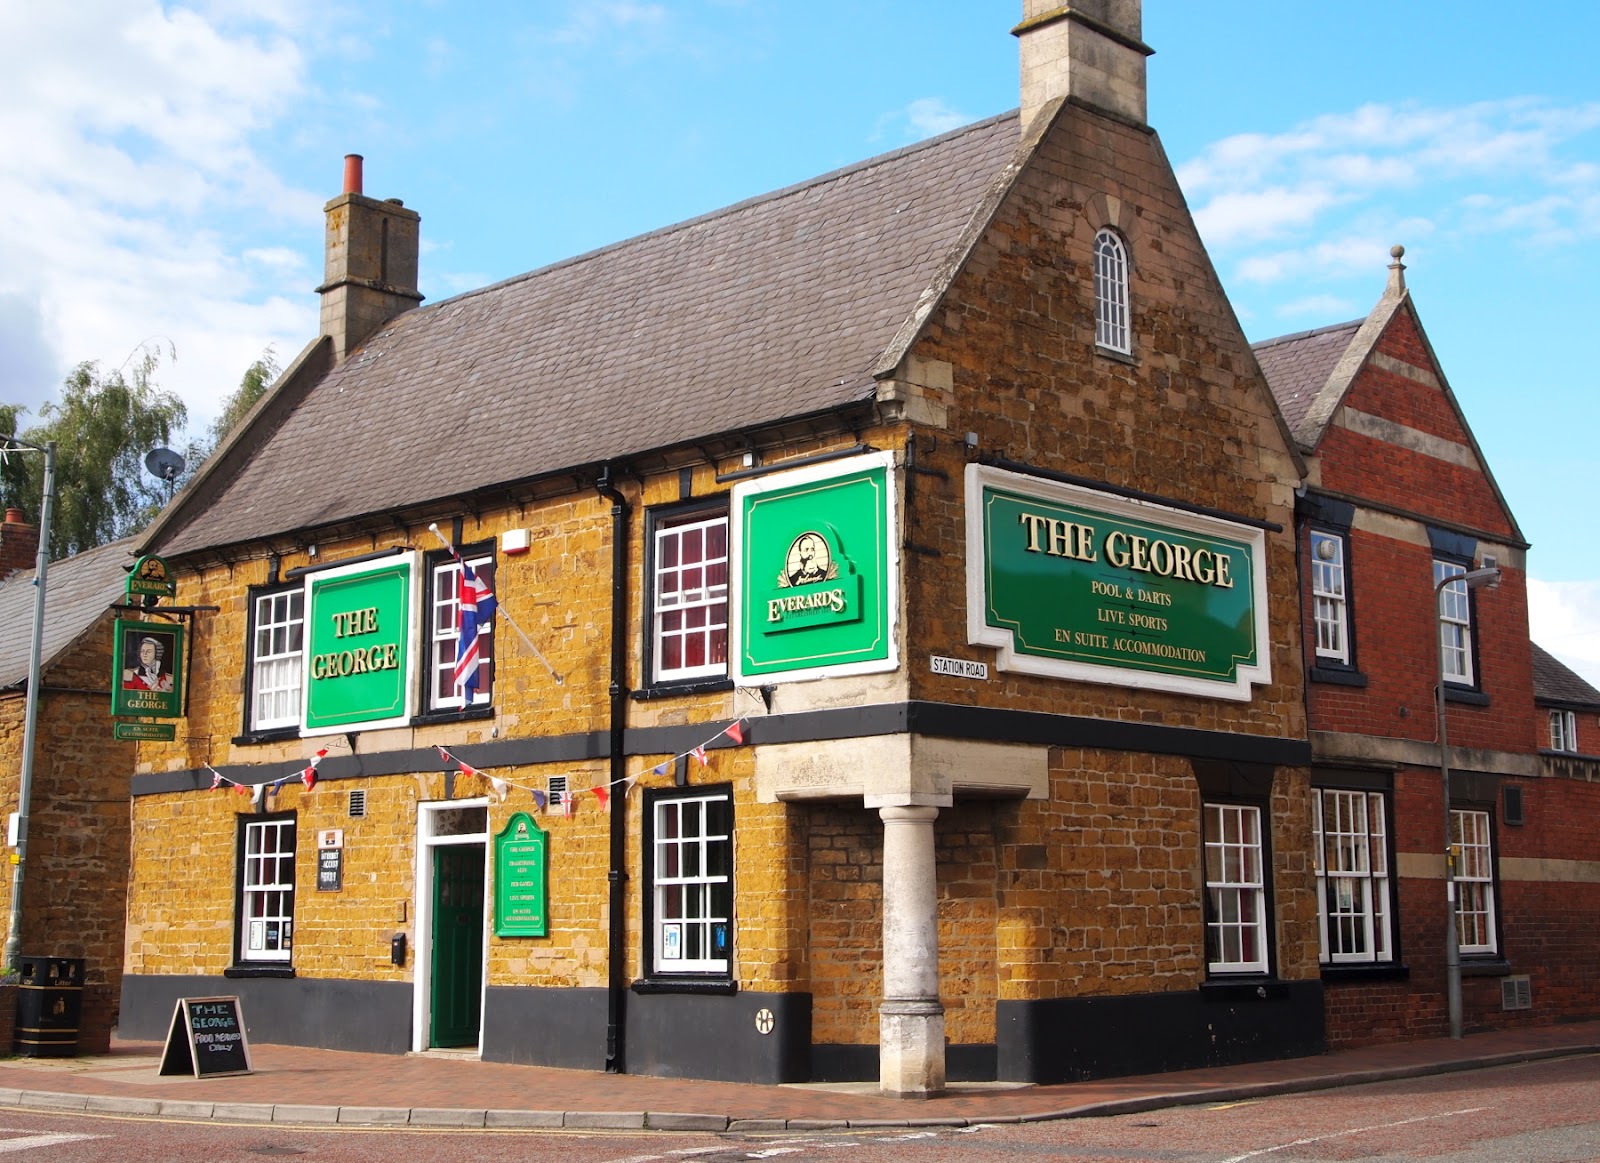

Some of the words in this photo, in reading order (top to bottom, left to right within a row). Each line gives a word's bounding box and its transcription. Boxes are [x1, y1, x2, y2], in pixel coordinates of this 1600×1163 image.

[1022, 513, 1097, 562] THE
[1106, 531, 1233, 588] GEORGE
[767, 589, 845, 621] EVERARDS
[1091, 581, 1122, 598] POOL
[1125, 587, 1134, 600] &
[1138, 589, 1172, 606] DARTS
[331, 606, 379, 637] THE
[1097, 608, 1125, 624] LIVE
[1128, 614, 1168, 631] SPORTS
[1055, 629, 1071, 643] EN
[1074, 632, 1109, 648] SUITE
[1112, 638, 1206, 662] ACCOMMODATION
[311, 643, 399, 680] GEORGE
[933, 658, 964, 674] STATION
[965, 662, 985, 677] ROAD
[127, 700, 168, 710] GEORGE
[137, 691, 159, 700] THE
[191, 1005, 229, 1015] THE
[191, 1017, 236, 1029] GEORGE
